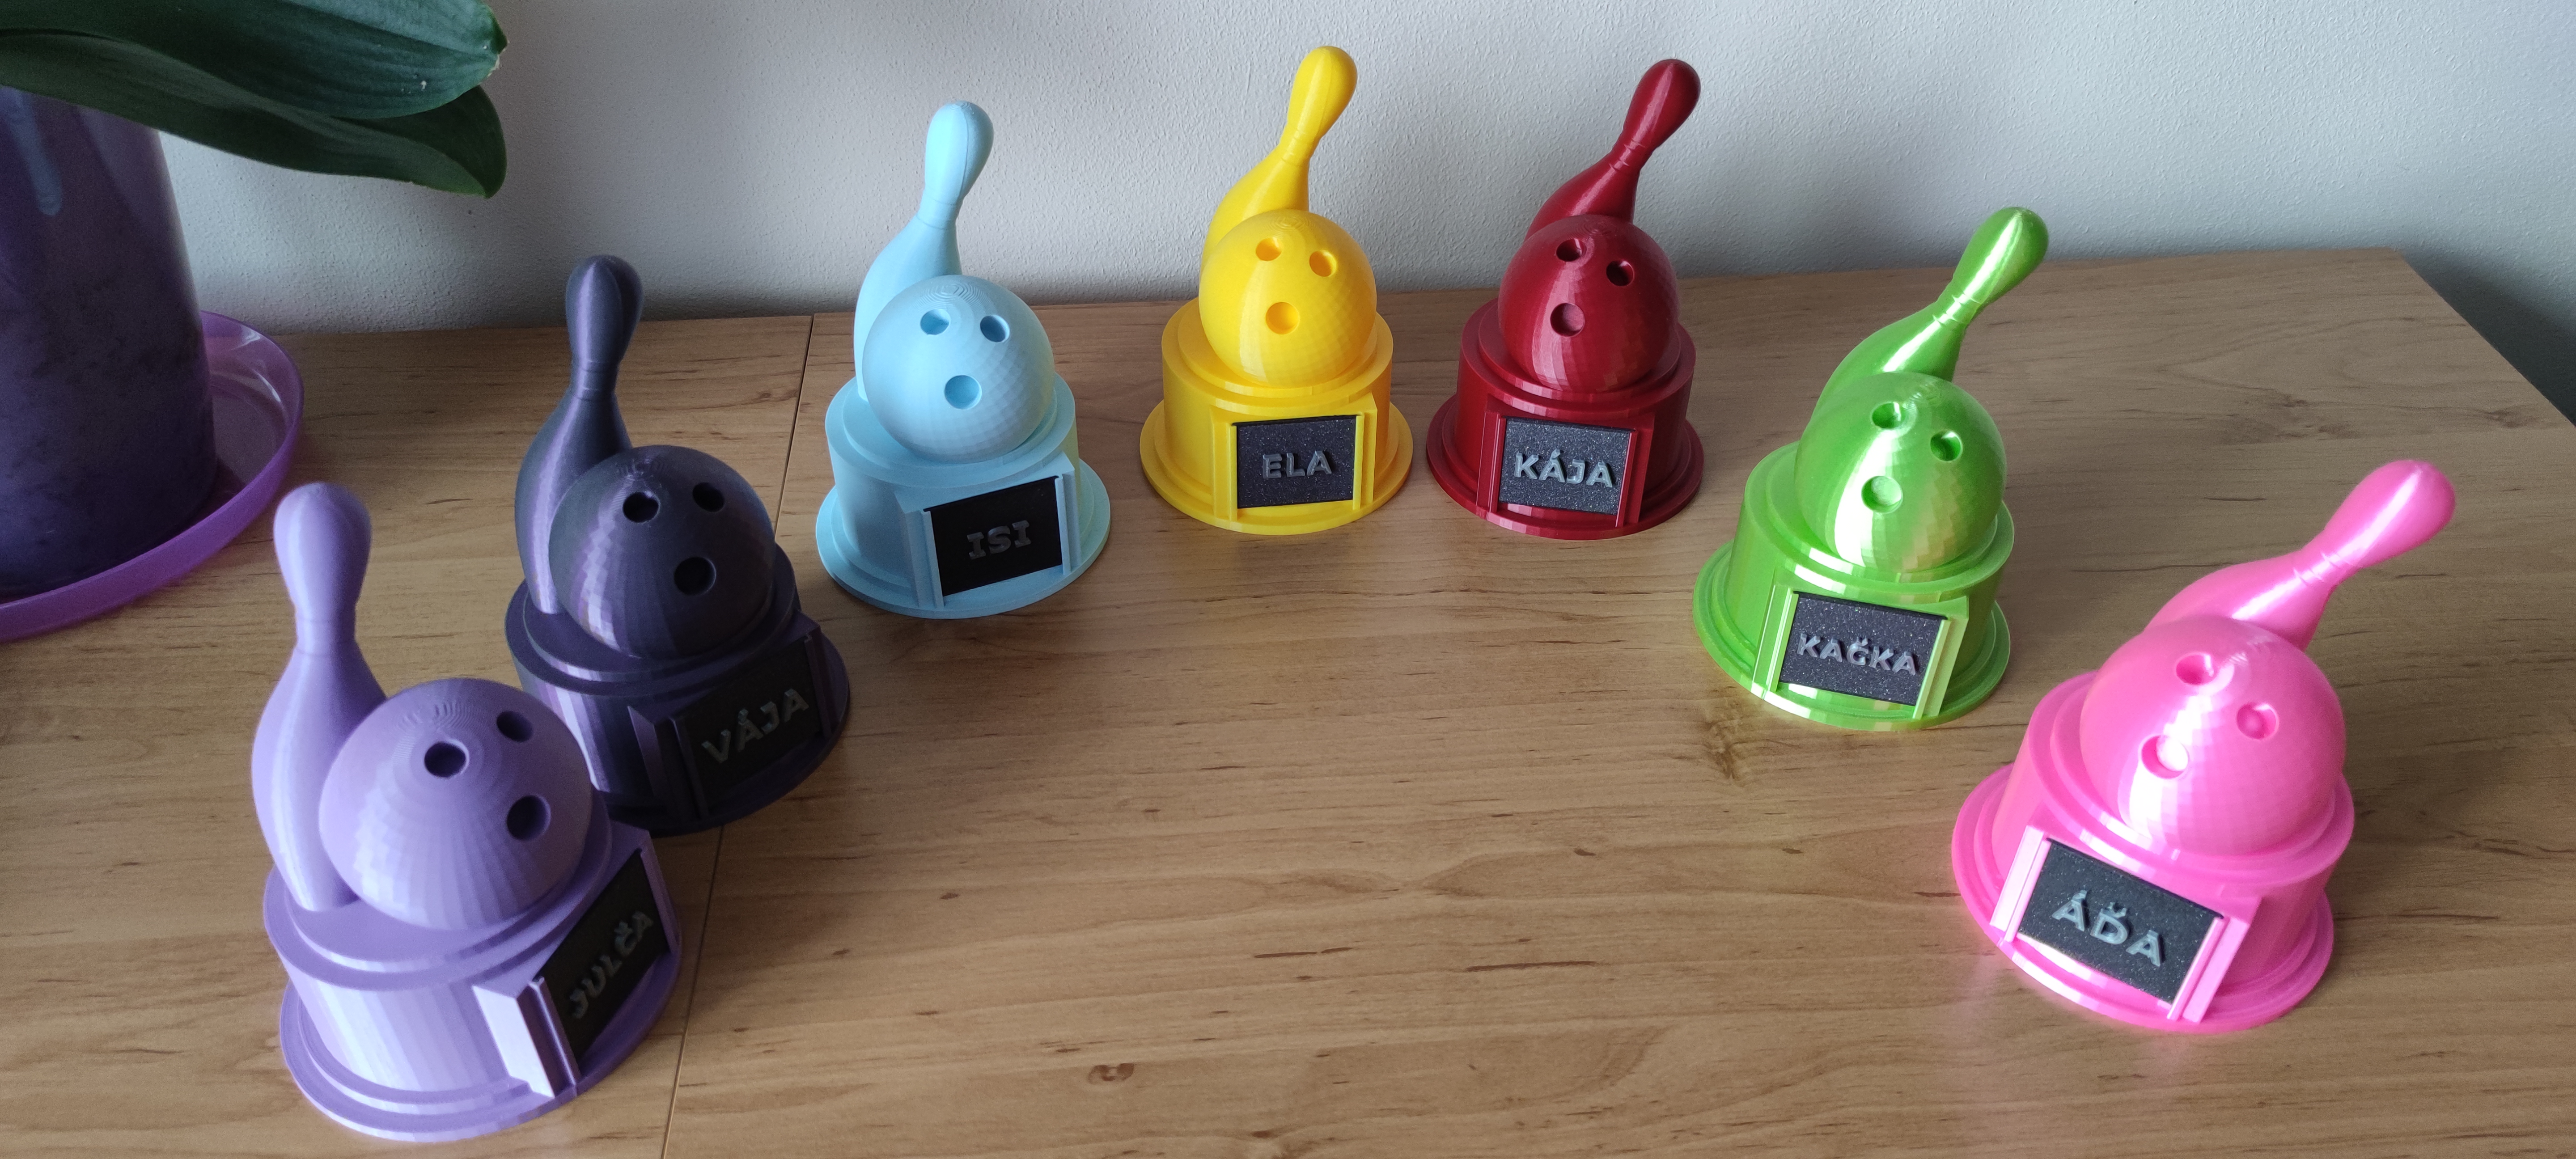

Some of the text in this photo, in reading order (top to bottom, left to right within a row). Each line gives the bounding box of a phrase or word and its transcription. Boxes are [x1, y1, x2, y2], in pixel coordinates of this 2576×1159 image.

[1262, 450, 1332, 479] ELA
[1514, 448, 1613, 488] KÁJA
[966, 520, 1032, 560] ISI
[1796, 632, 1916, 676] KAČKA
[701, 688, 810, 764] VÁJA
[2051, 889, 2161, 967] ÁĎA
